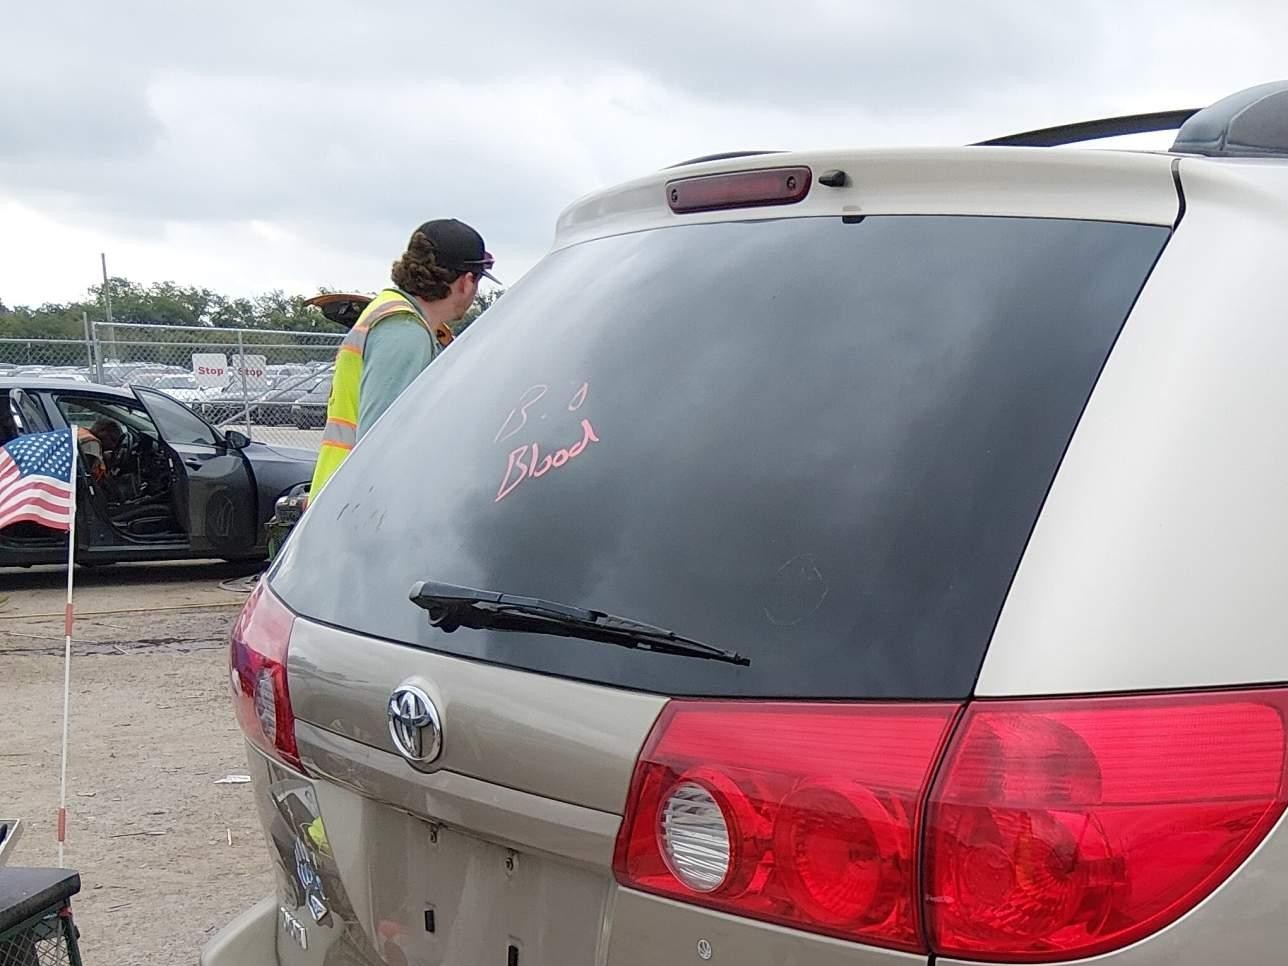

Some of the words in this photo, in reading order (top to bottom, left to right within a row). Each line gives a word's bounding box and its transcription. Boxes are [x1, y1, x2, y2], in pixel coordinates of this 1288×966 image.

[198, 366, 224, 377] Stop
[238, 367, 263, 377] Stop
[494, 418, 600, 503] Blood
